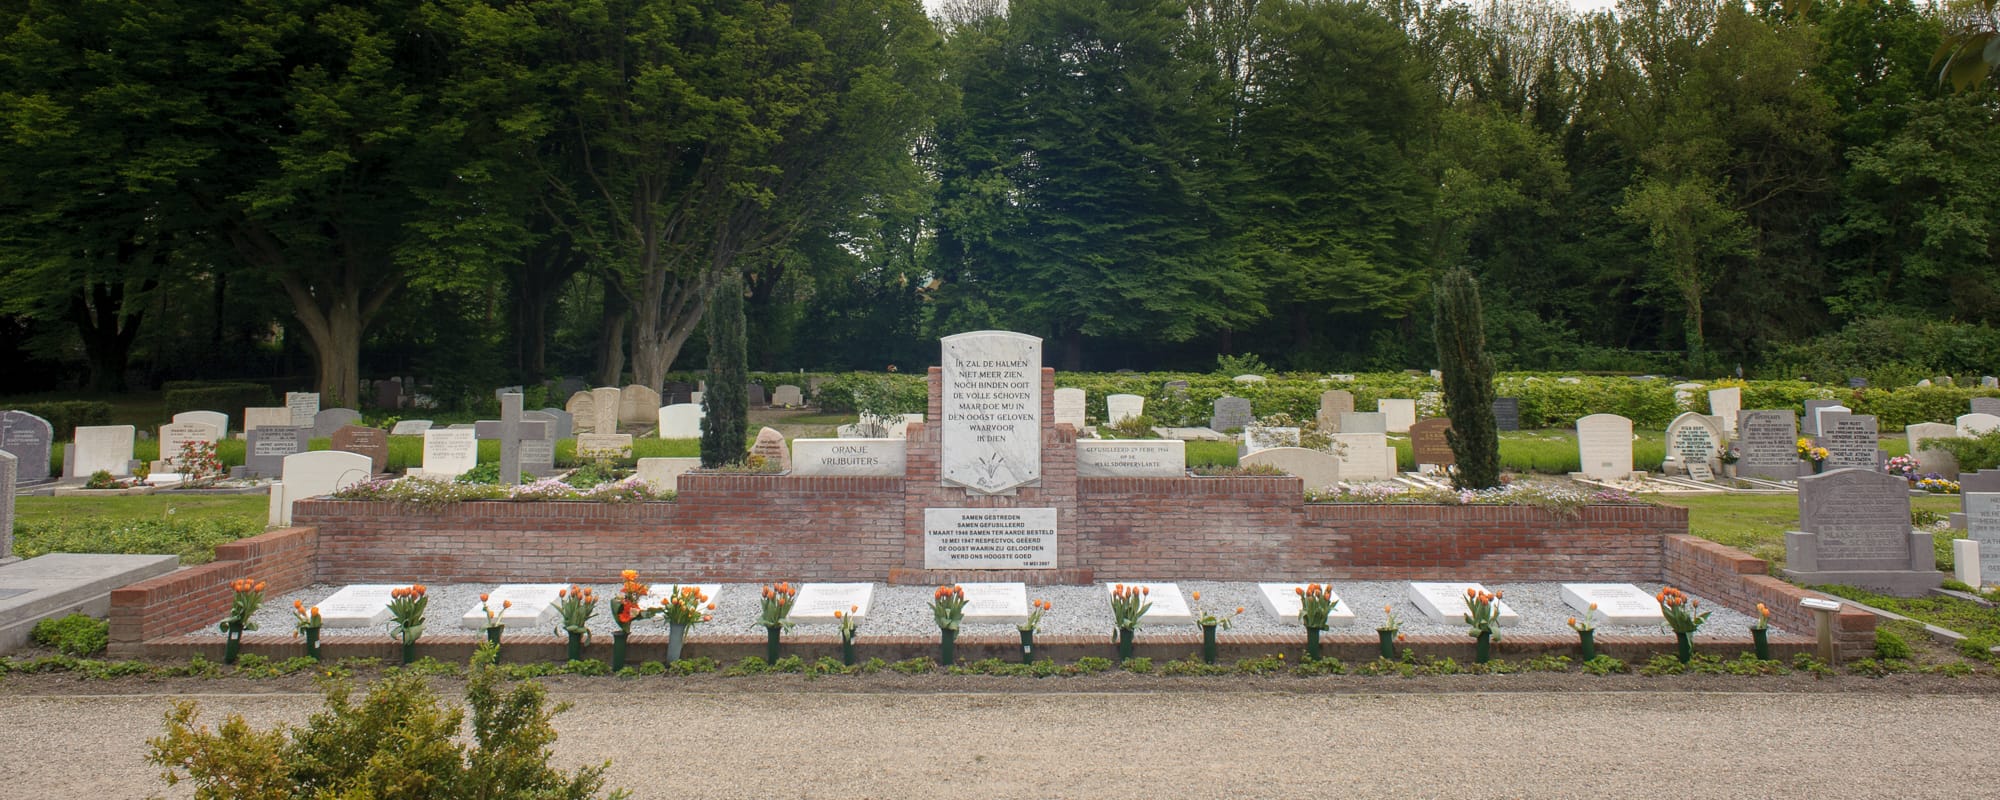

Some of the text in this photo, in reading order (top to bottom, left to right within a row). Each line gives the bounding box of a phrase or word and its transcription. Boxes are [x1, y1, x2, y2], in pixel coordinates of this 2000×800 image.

[956, 359, 964, 367] IK
[959, 371, 977, 379] NIET
[979, 371, 1001, 379] MEER
[832, 446, 869, 454] ORANJE
[821, 457, 879, 466] VRIJBUITERS
